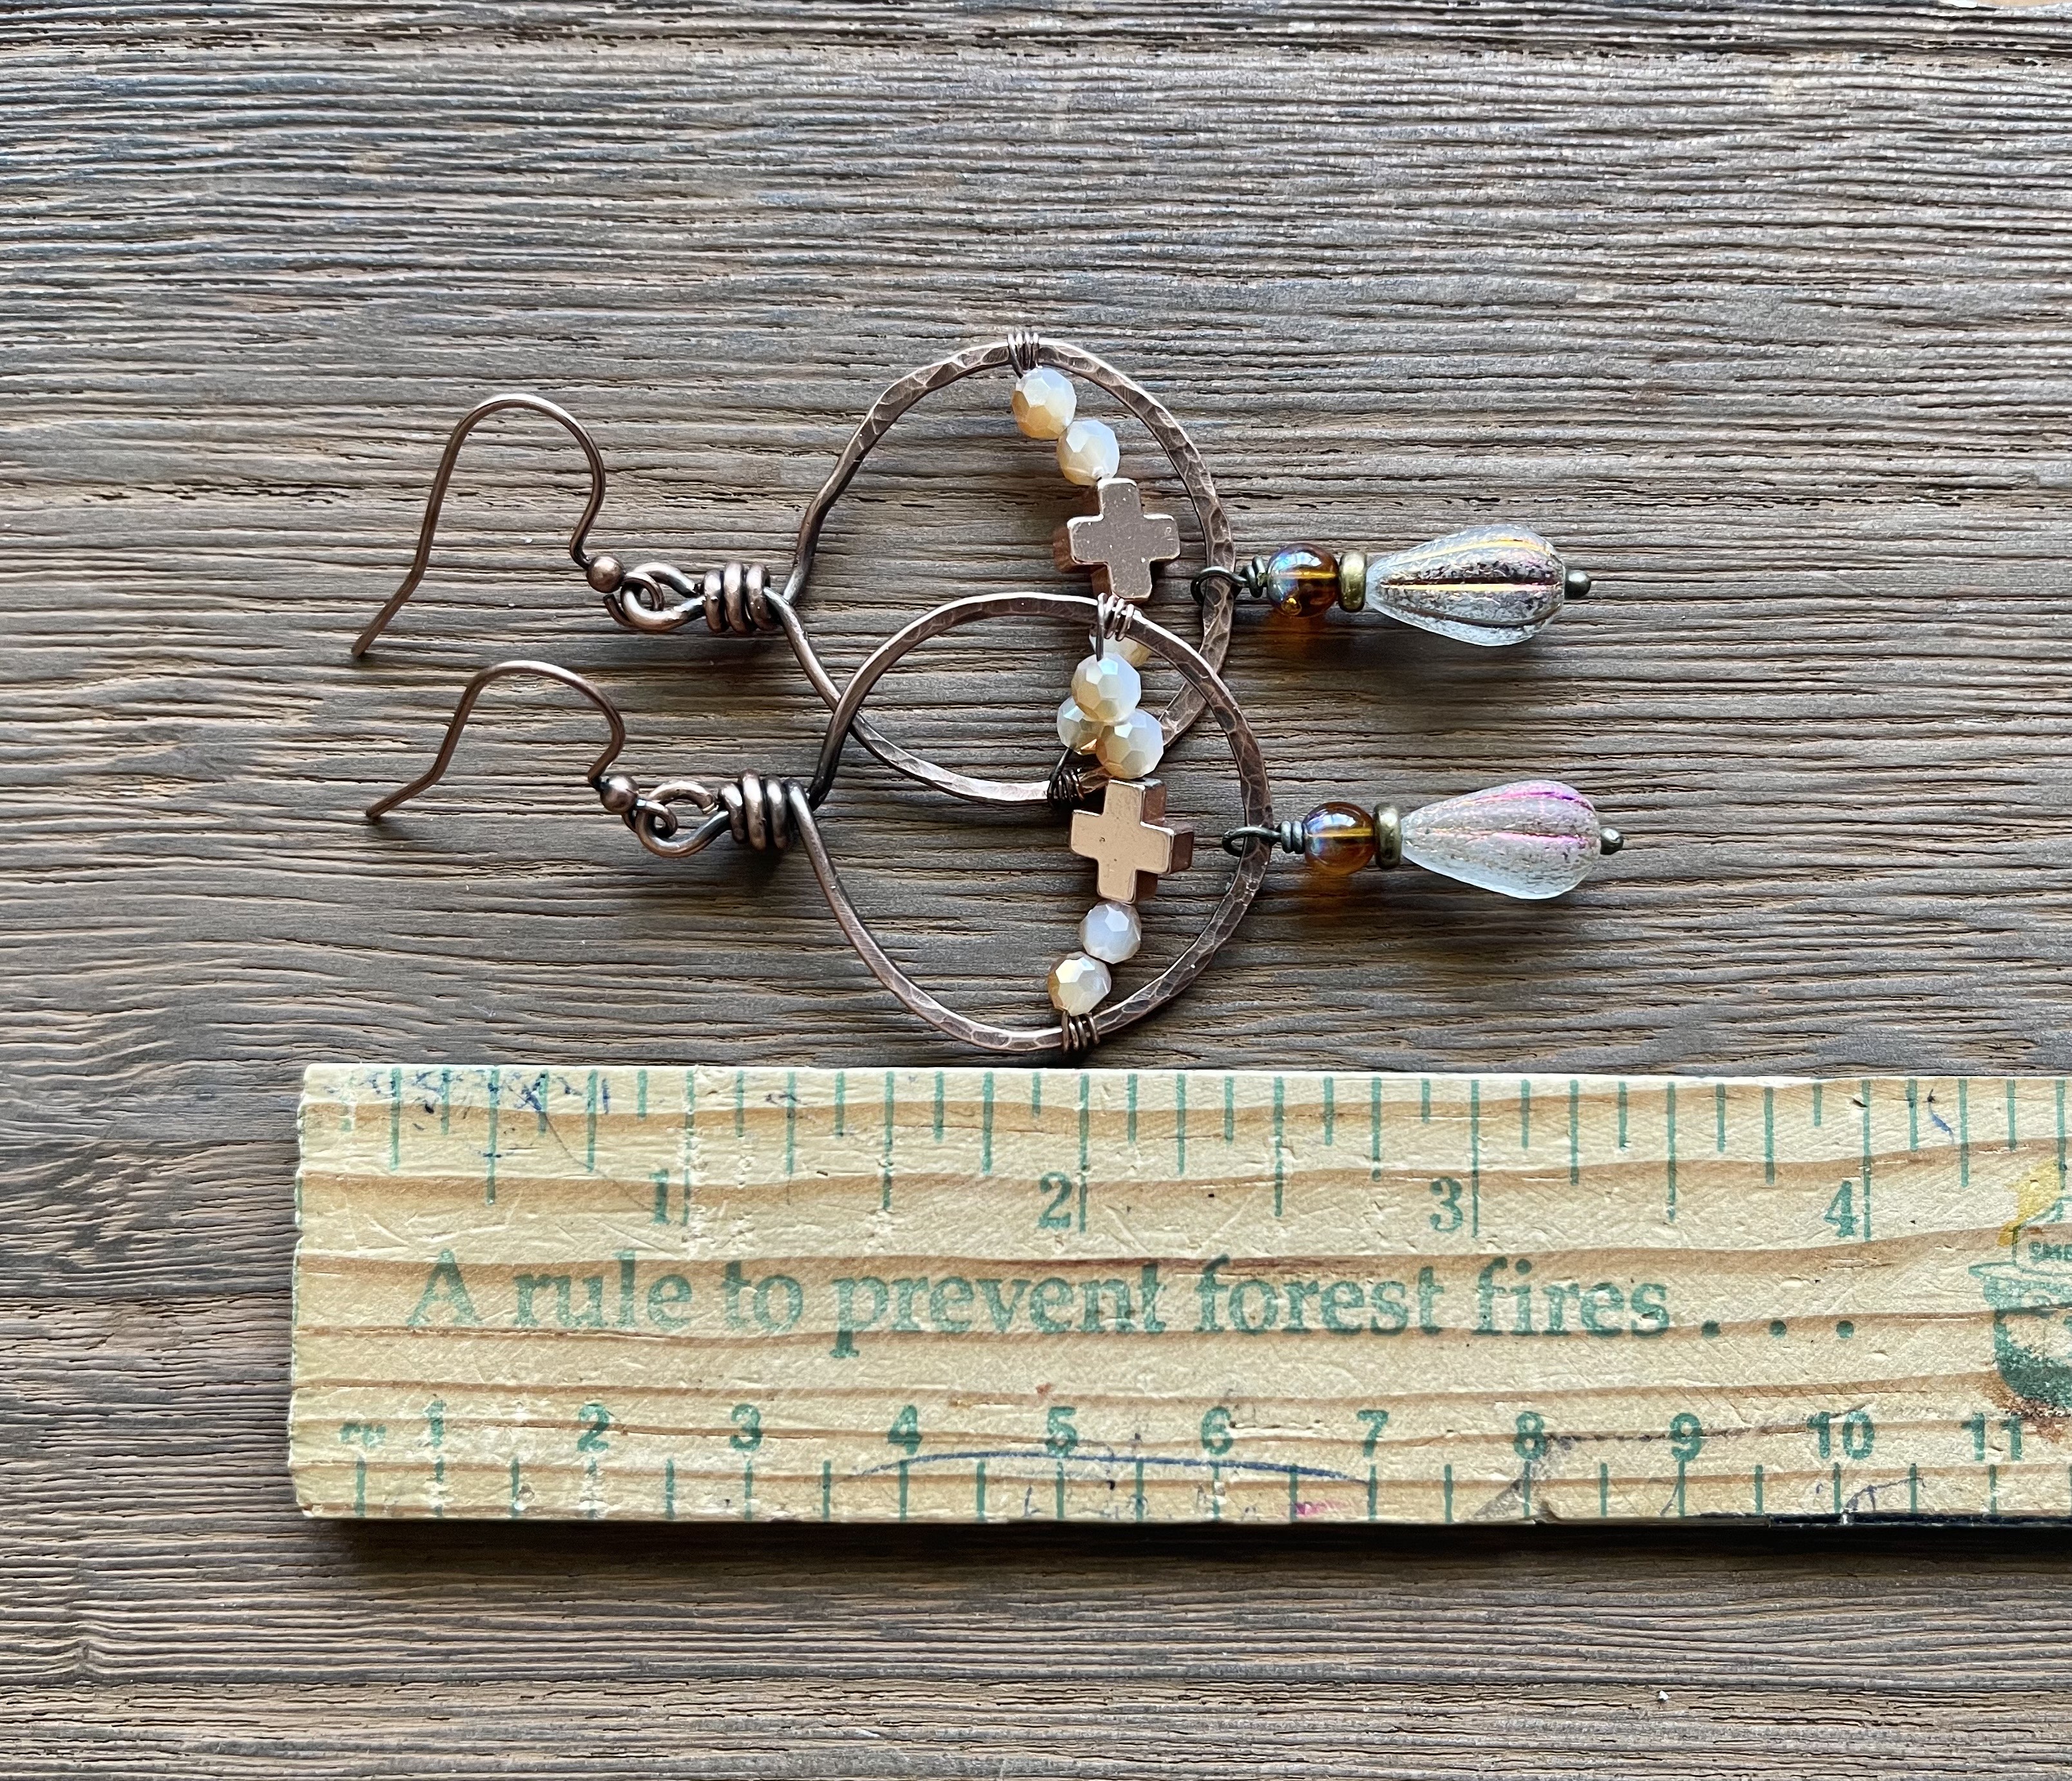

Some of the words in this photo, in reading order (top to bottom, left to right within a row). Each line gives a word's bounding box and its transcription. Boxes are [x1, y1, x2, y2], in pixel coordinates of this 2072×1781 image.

[646, 1169, 671, 1226] 1
[1036, 1171, 1073, 1229] 2
[1429, 1177, 1463, 1233] 3
[1823, 1181, 1859, 1237] 4
[407, 1249, 479, 1325] A
[512, 1249, 692, 1330] rule
[722, 1263, 804, 1332] to
[829, 1268, 1166, 1358] prevent
[1193, 1254, 1444, 1335] forest
[1472, 1256, 1671, 1338] fires
[425, 1400, 446, 1449] 1
[575, 1402, 611, 1454] 2
[729, 1403, 762, 1453] 3
[887, 1404, 923, 1455] 4
[1044, 1406, 1078, 1458] 5
[1200, 1407, 1233, 1456] 6
[1356, 1410, 1390, 1458] 7
[1513, 1410, 1546, 1460] 8
[1669, 1412, 1703, 1462] 9
[1807, 1410, 1875, 1461] 10
[1963, 1412, 2023, 1463] 11
